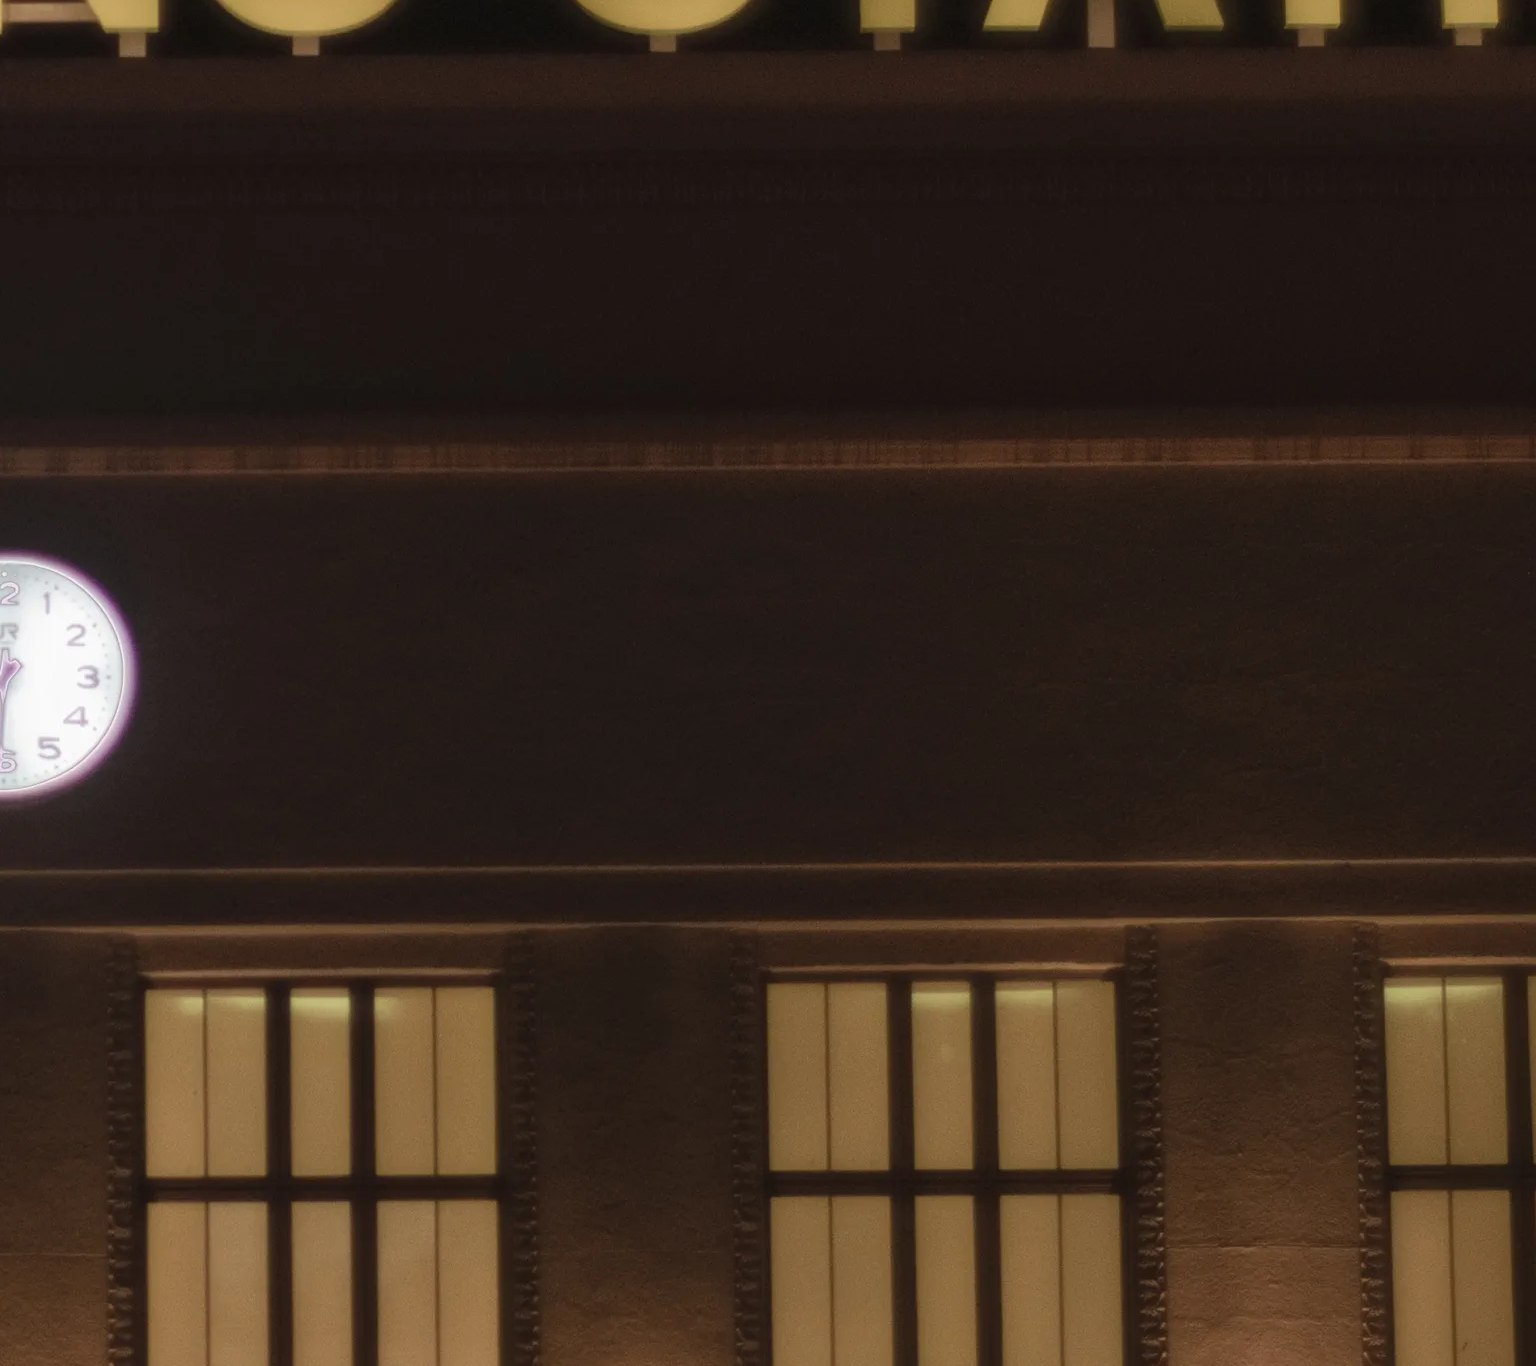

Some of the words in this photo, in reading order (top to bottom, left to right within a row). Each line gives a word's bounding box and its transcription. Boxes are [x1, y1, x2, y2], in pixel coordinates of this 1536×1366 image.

[42, 591, 51, 615] 1
[66, 623, 86, 647] 2
[77, 665, 99, 689] 3
[63, 706, 88, 727] 4
[37, 736, 61, 760] 5
